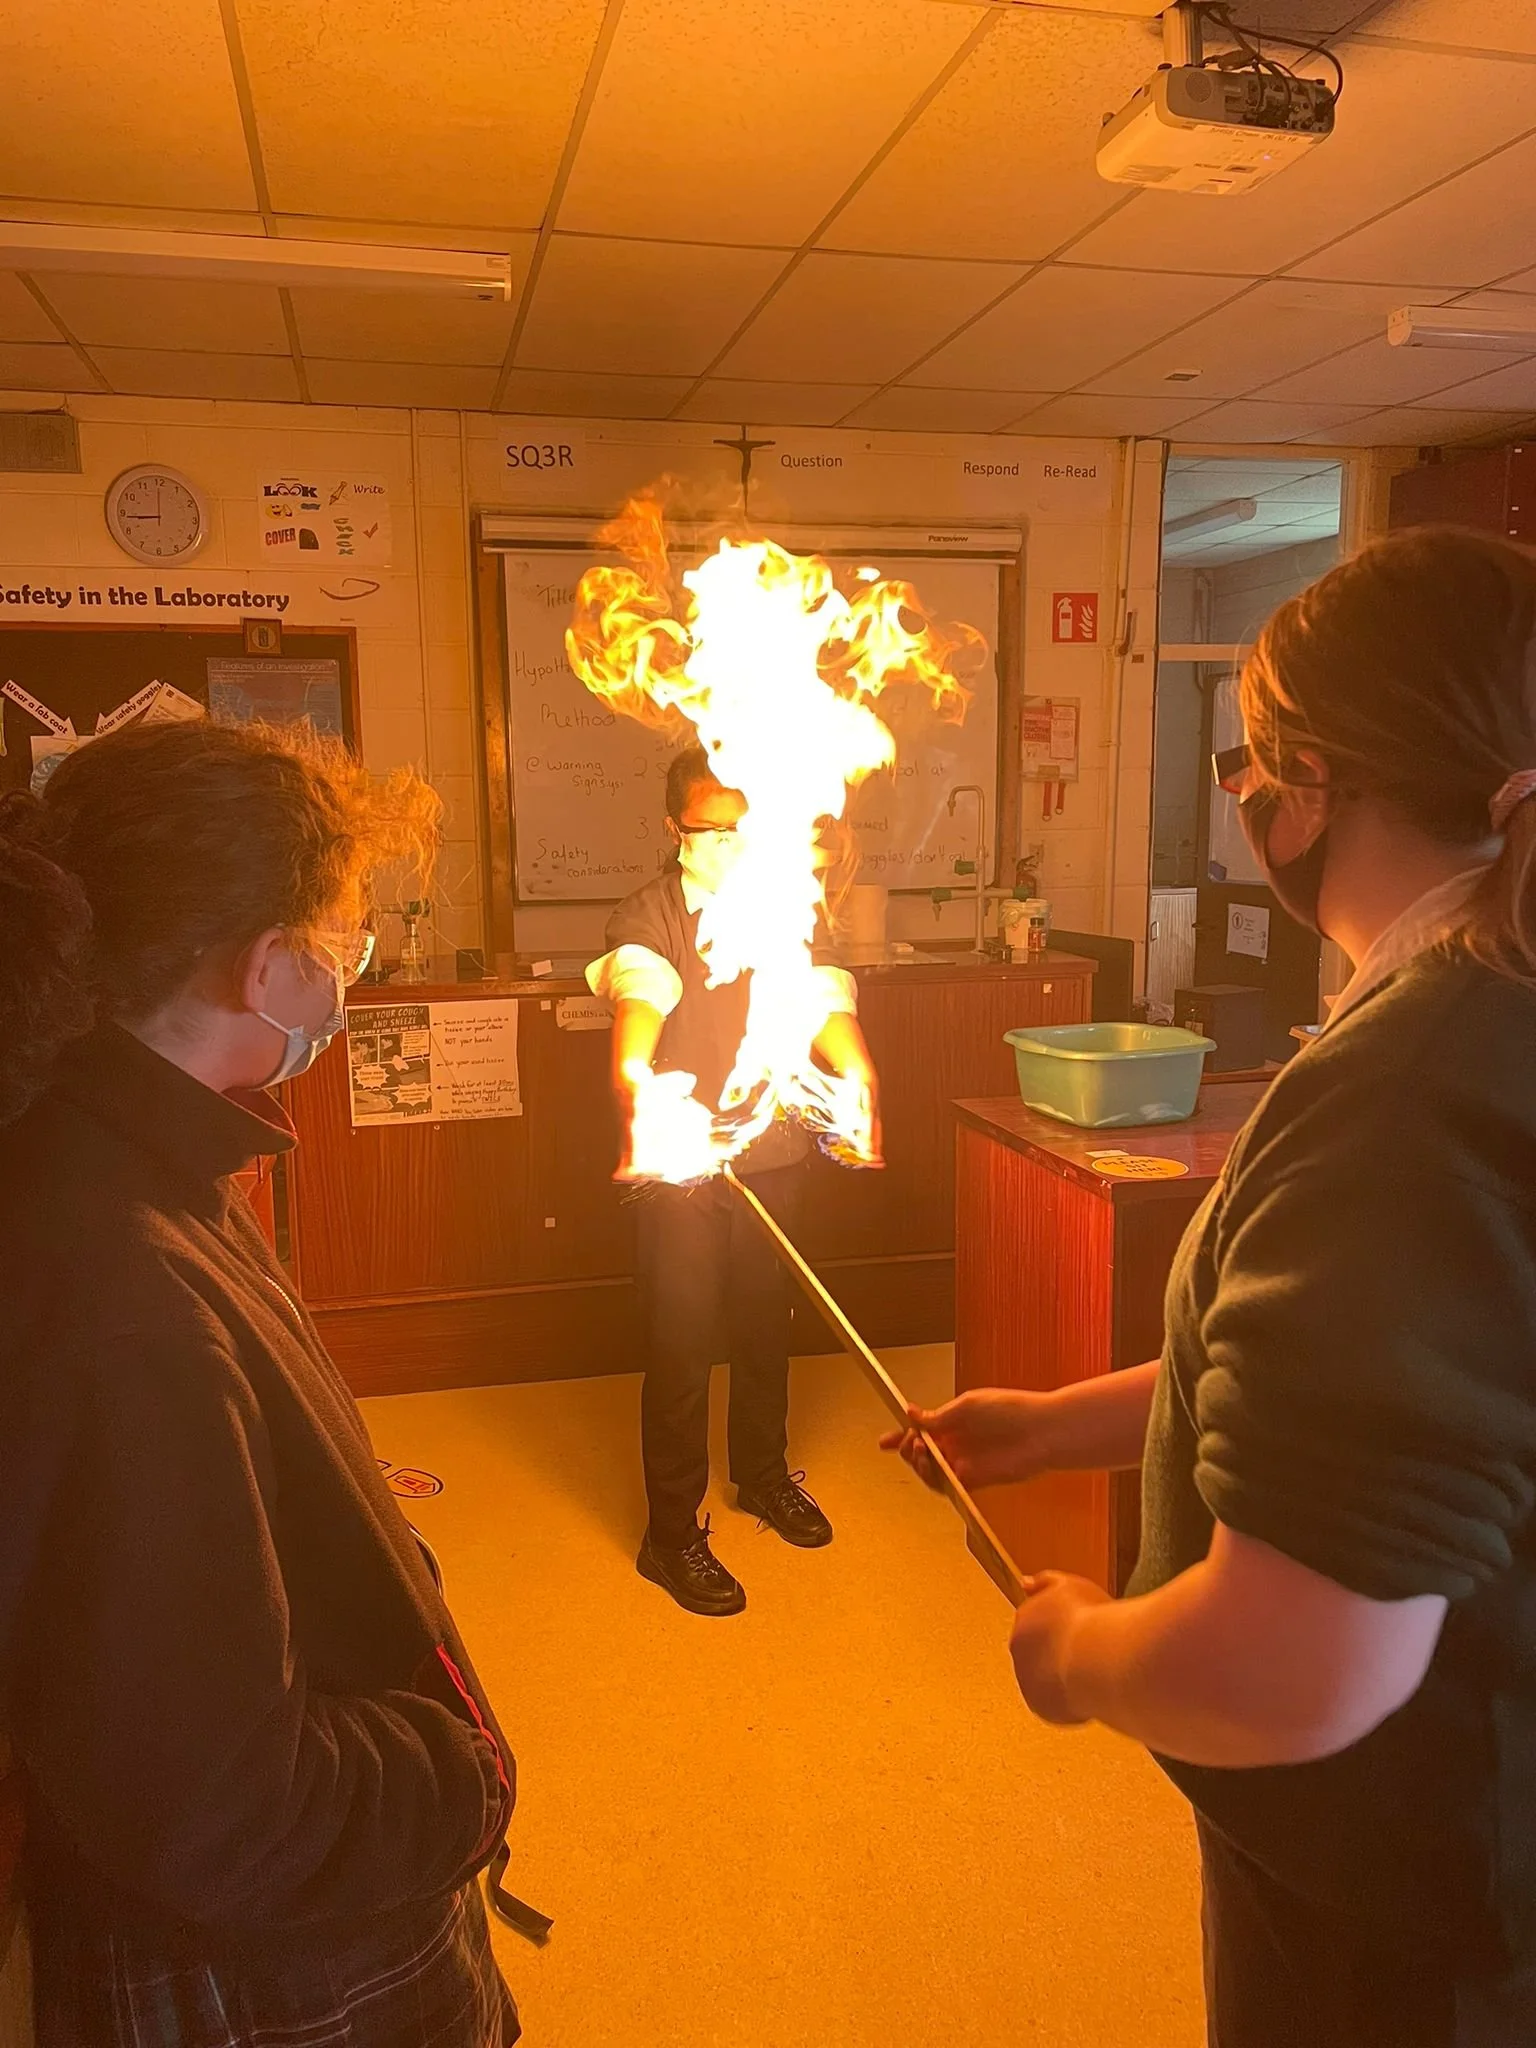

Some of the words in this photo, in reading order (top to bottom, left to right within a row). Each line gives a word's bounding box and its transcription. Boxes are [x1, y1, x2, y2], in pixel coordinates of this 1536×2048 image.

[506, 445, 574, 469] SQ3R
[780, 454, 843, 469] Question
[963, 461, 1019, 477] Respond
[1043, 465, 1097, 478] Re-Read
[154, 478, 165, 487] 12
[354, 484, 386, 495] Write
[125, 492, 136, 501] 10
[187, 499, 193, 508] 2
[120, 509, 126, 517] 9
[126, 526, 132, 535] 8
[265, 527, 297, 546] COVER
[78, 586, 102, 605] in
[108, 587, 148, 606] the
[154, 587, 290, 612] Laboratory
[6, 682, 28, 703] Wear
[35, 705, 50, 720] lab
[49, 719, 69, 735] coat
[540, 703, 616, 728] Method
[96, 719, 116, 736] Wear
[115, 703, 138, 721] safety
[634, 816, 649, 840] 3
[535, 838, 589, 864] Safety
[567, 860, 644, 878] considerations
[350, 1012, 374, 1024] COVER
[376, 1009, 396, 1019] YOUR
[398, 1006, 424, 1016] COUGH
[372, 1020, 388, 1029] AND
[390, 1016, 417, 1027] SNEEZE
[445, 1037, 457, 1045] NOT
[460, 1038, 473, 1047] your
[474, 1035, 493, 1044] hands
